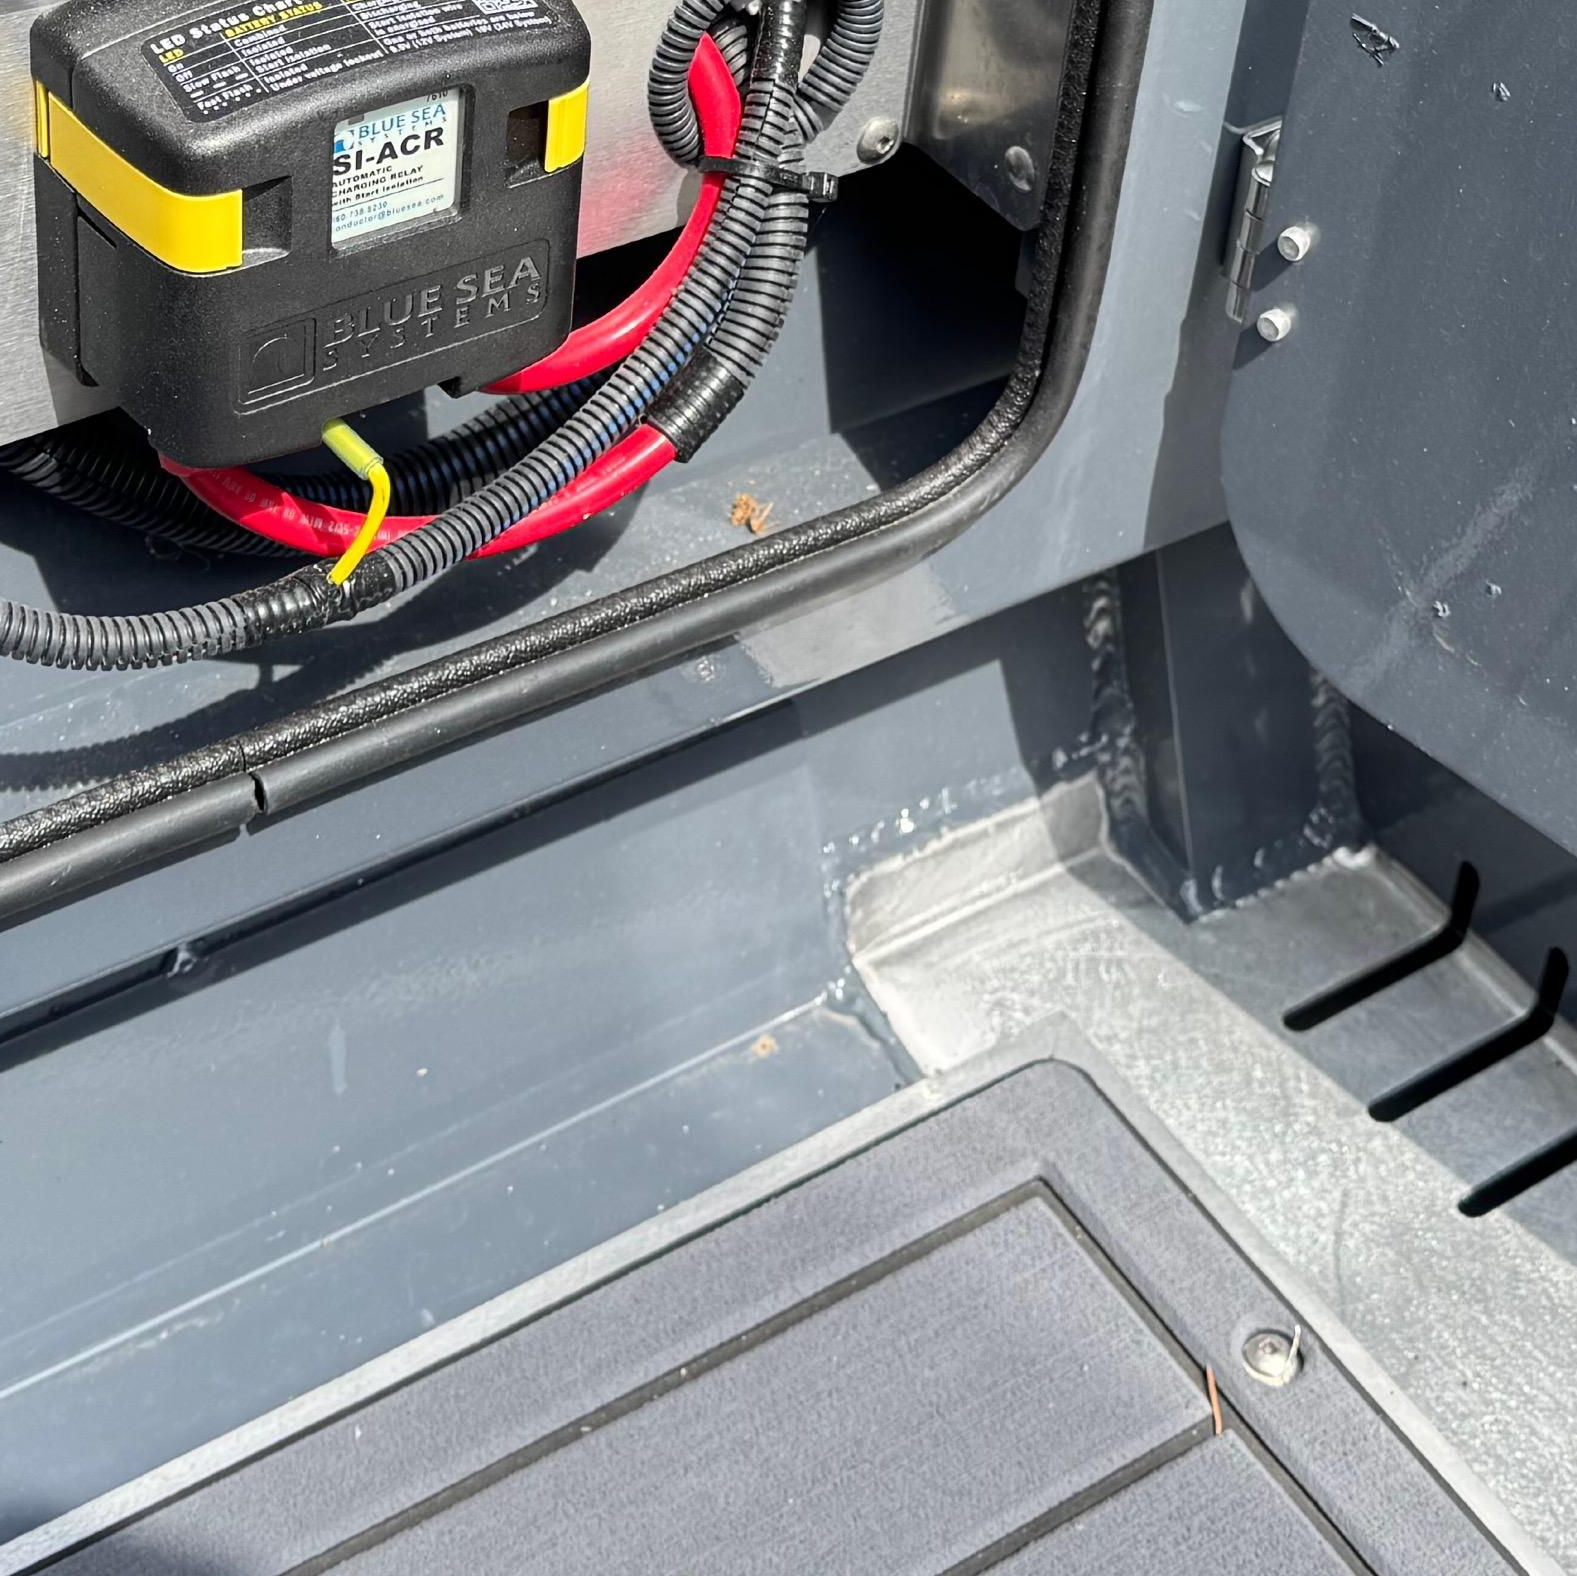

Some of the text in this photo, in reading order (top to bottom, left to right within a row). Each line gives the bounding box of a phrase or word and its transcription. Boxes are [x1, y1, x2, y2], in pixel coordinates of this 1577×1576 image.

[226, 1, 323, 38] BATTERY STATUS
[359, 0, 422, 21] Discharging
[150, 33, 186, 54] LED
[189, 11, 250, 39] Status
[234, 24, 287, 48] Combined
[420, 25, 443, 38] both
[159, 47, 184, 64] LED
[167, 62, 184, 73] On
[255, 59, 285, 74] Start
[175, 70, 193, 83] Off
[183, 65, 241, 93] Slow Flash
[269, 76, 303, 92] Under
[197, 84, 253, 111] Fast Flash
[359, 103, 446, 139] BLUE SEA
[333, 126, 444, 176] SI-ACR
[332, 165, 393, 188] AUTOMATIC
[332, 164, 424, 198] CHARGING RELAY
[335, 194, 444, 232] onductor@bluesea.com
[324, 256, 542, 349] BLUE SEA
[323, 283, 541, 371] SYSTEMS
